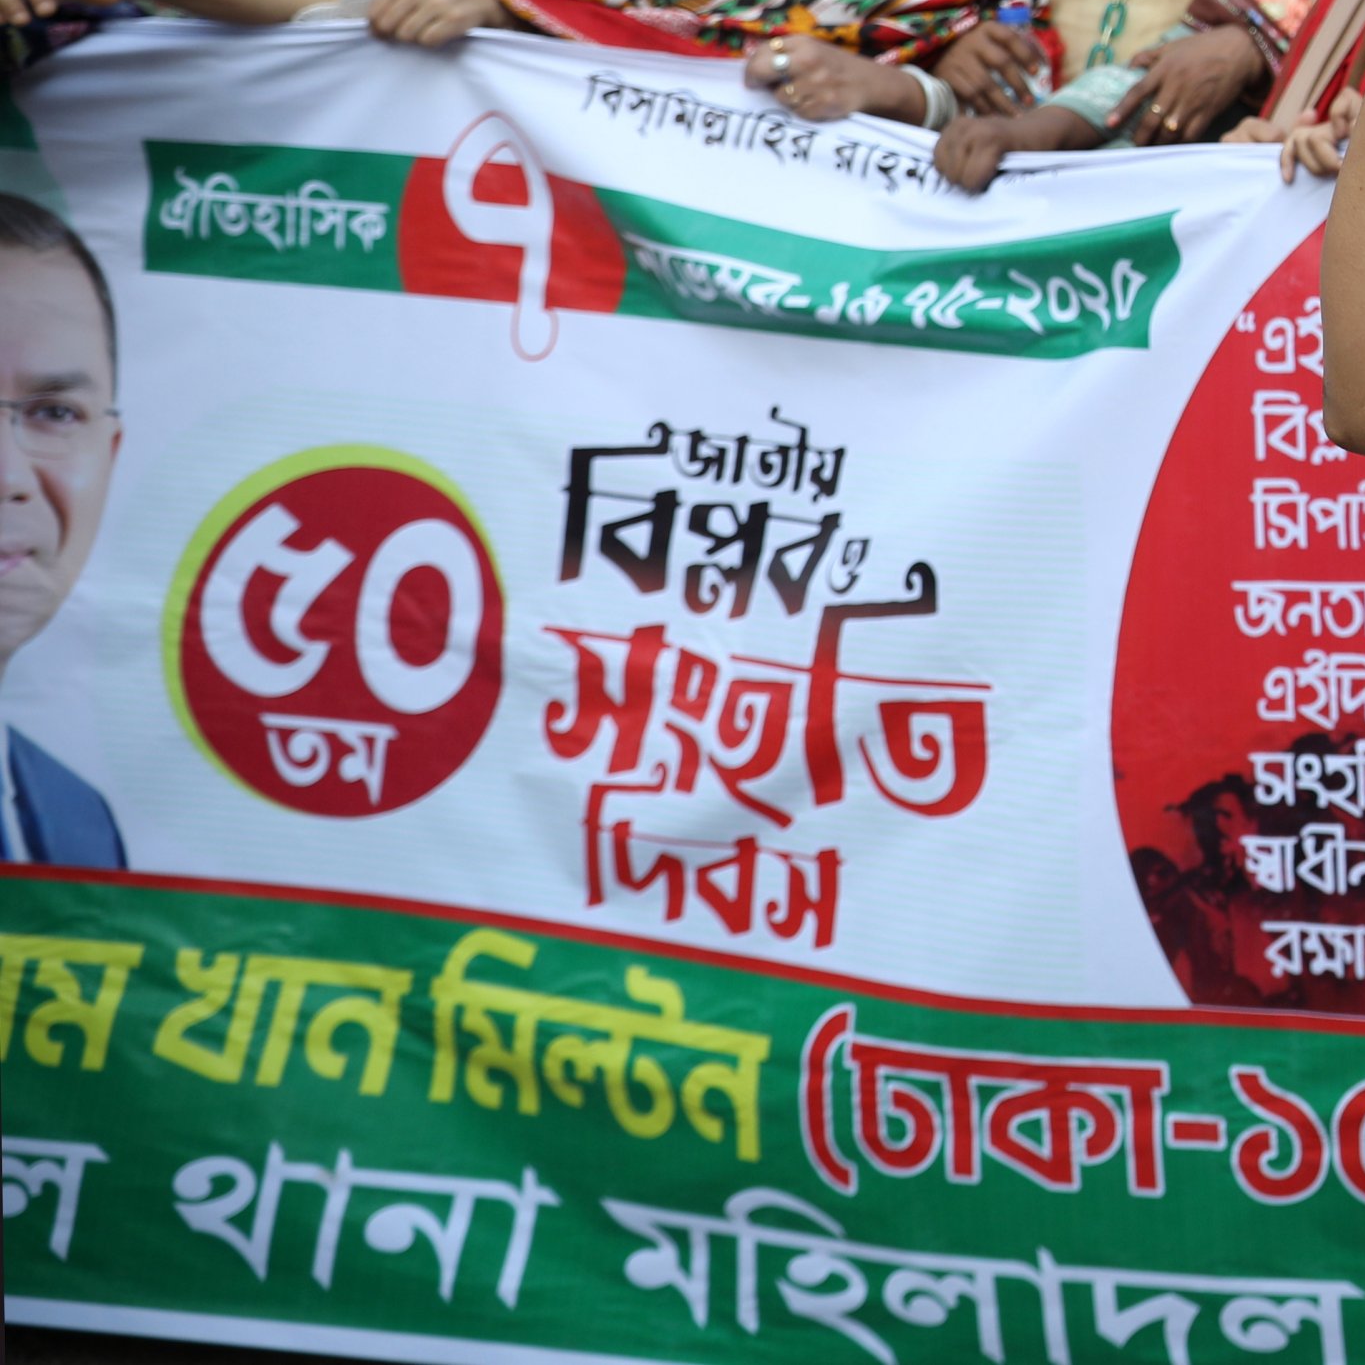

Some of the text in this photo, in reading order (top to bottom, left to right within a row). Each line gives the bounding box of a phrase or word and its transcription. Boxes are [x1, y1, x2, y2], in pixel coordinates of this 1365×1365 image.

[159, 167, 391, 252] ঐতিহাসিক
[442, 112, 561, 362] ৭
[556, 422, 873, 622] বিপ্লব ও
[660, 405, 847, 503] জাতীয়
[199, 503, 483, 719] ৫০
[540, 561, 993, 830] সংহতি
[259, 712, 399, 807] তম
[580, 761, 846, 949] দিবস
[152, 943, 413, 1098] খান
[427, 927, 773, 1165] মিল্টন
[172, 1138, 562, 1312] থানা
